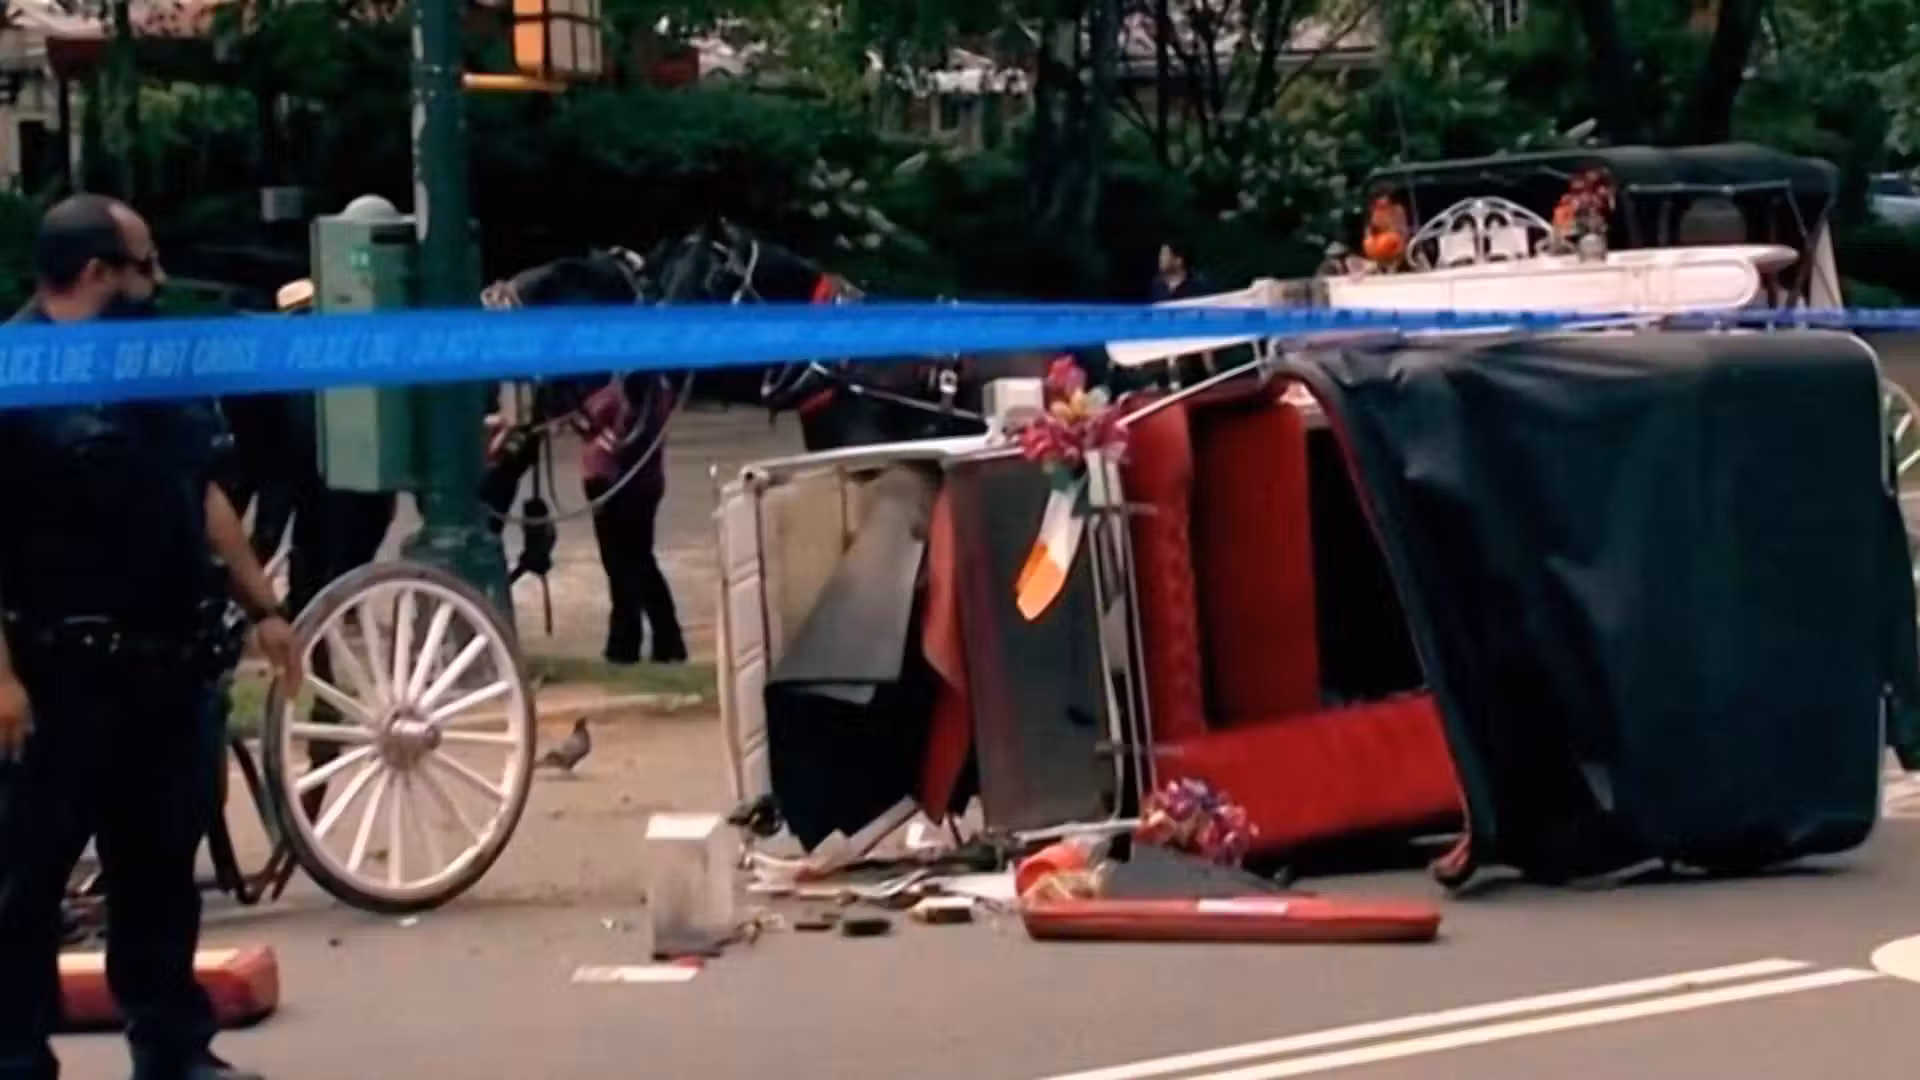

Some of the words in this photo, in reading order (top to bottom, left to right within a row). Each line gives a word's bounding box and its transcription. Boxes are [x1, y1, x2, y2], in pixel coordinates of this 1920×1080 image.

[48, 341, 96, 383] LINE
[113, 340, 146, 381] DO
[147, 337, 190, 378] NOT
